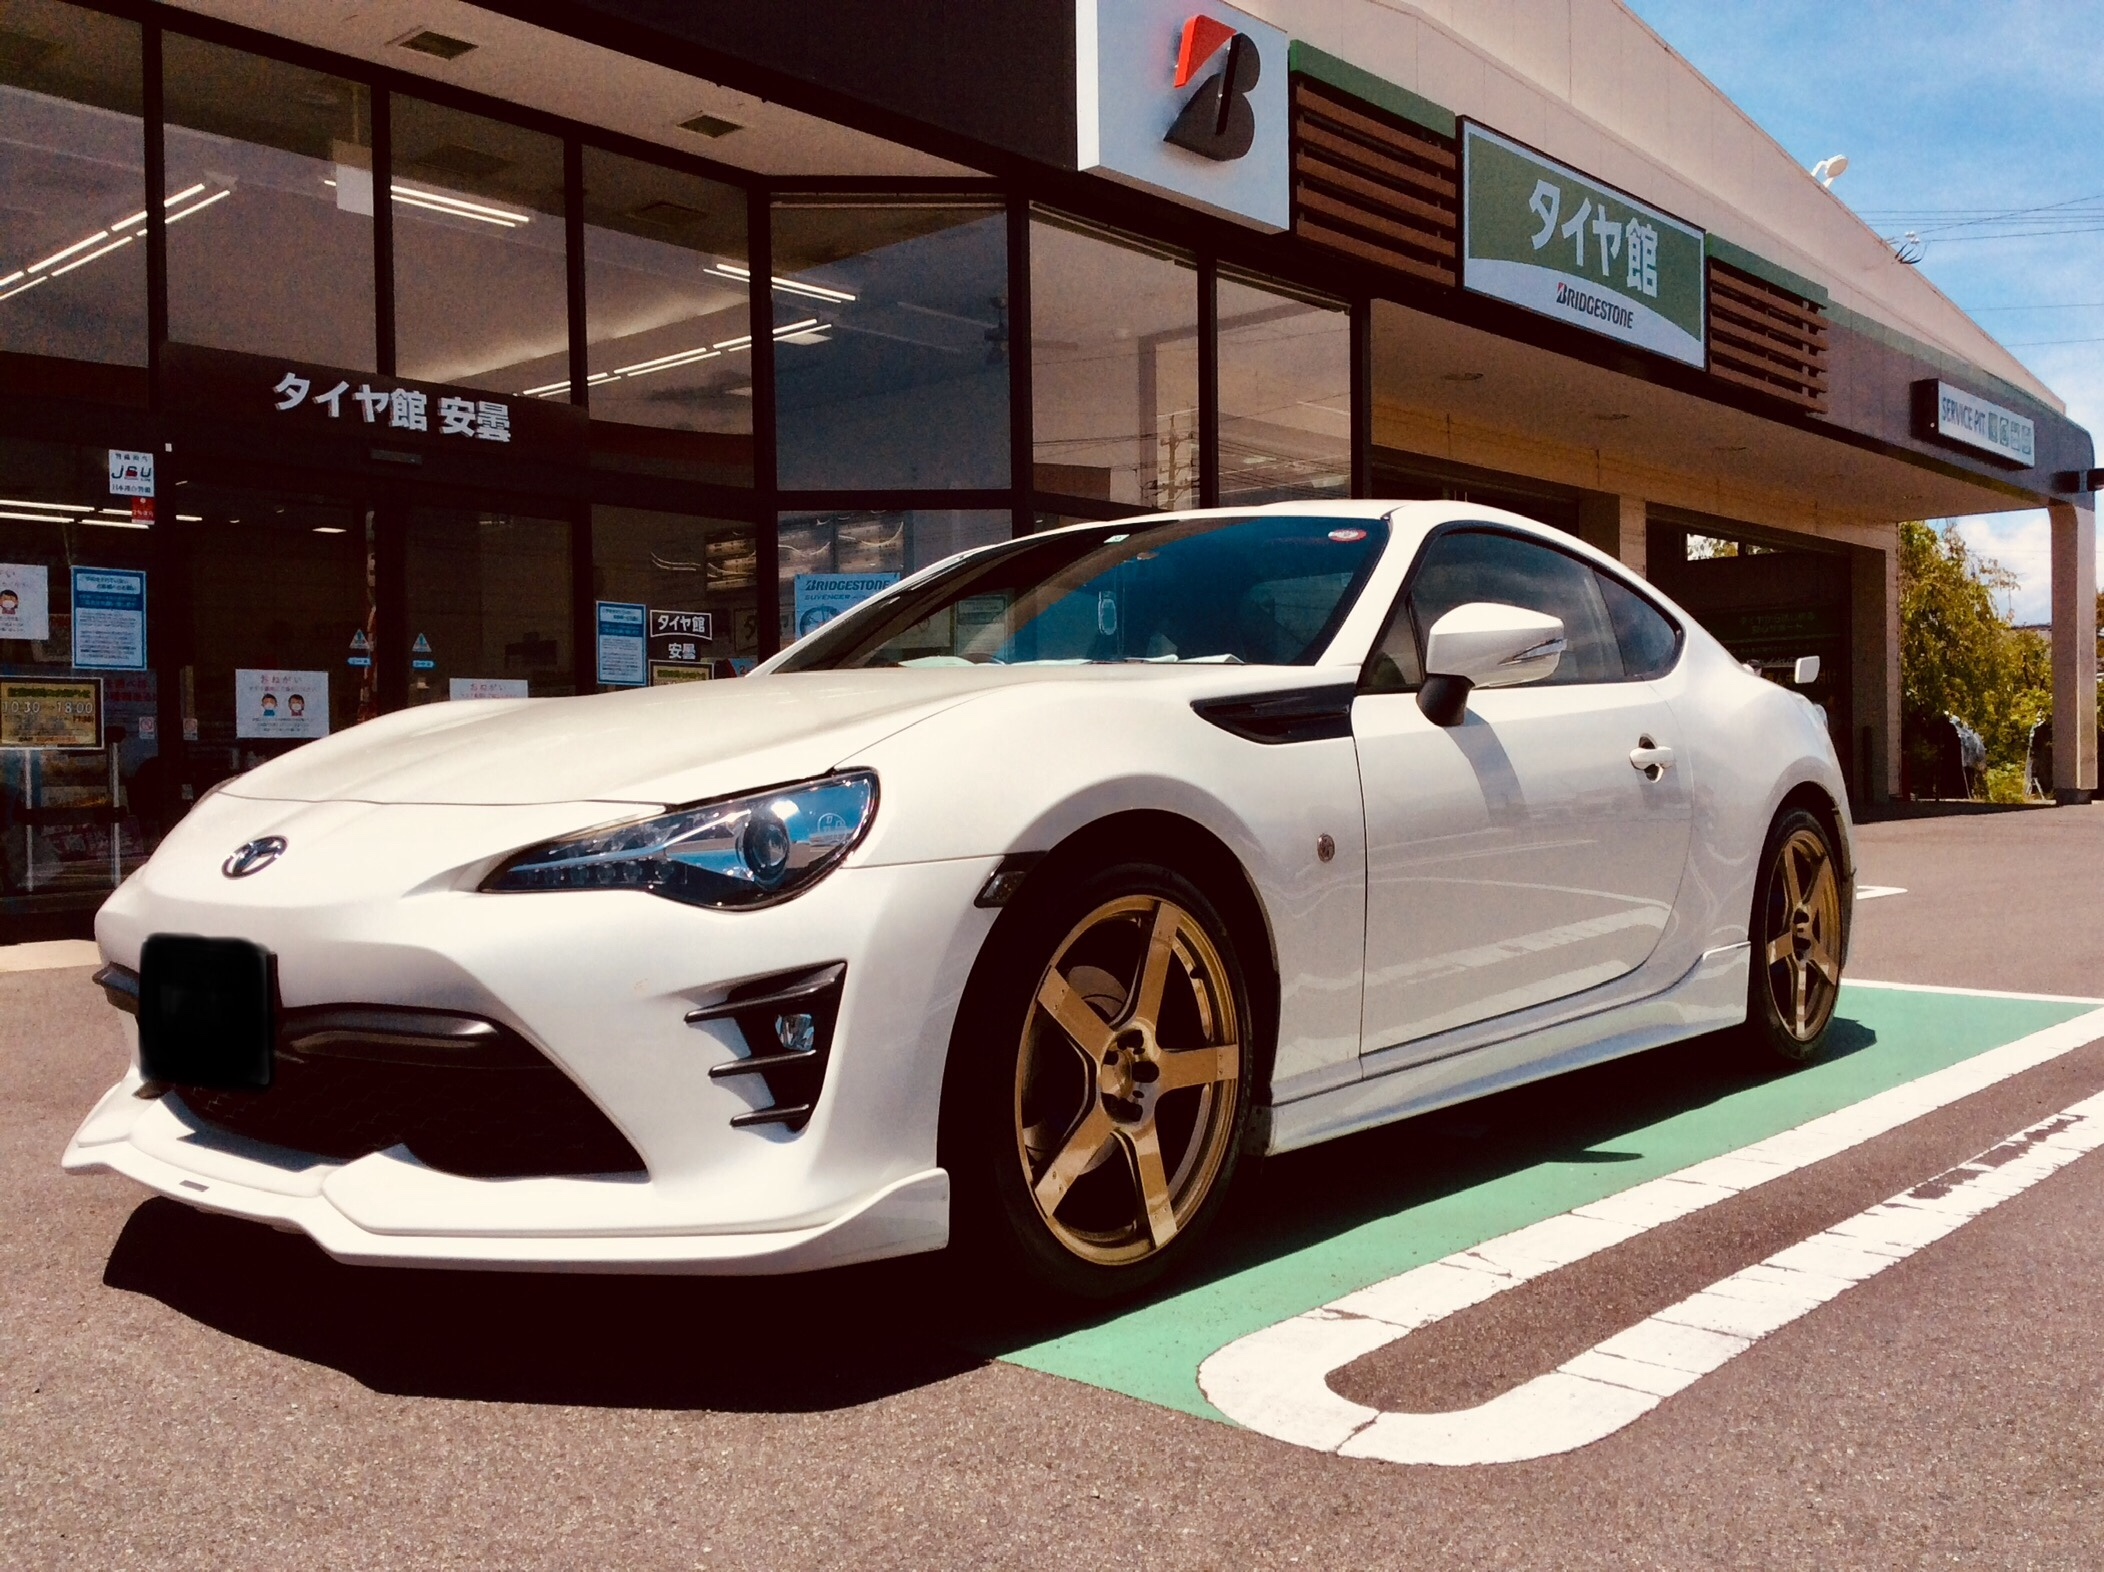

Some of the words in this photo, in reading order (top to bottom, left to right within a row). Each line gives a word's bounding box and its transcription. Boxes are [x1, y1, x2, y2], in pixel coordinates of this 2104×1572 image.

[1529, 179, 1658, 298] タイヤ館
[1556, 282, 1634, 329] BRIDGESTONE
[273, 372, 428, 432] タイヤ館
[437, 397, 511, 442] 安曇
[1942, 397, 1972, 431] SERVICE
[1974, 409, 1986, 436] PIT
[805, 580, 890, 591] BRIDGESTONE
[657, 615, 705, 633] タイヤ館
[668, 643, 696, 659] 安曇
